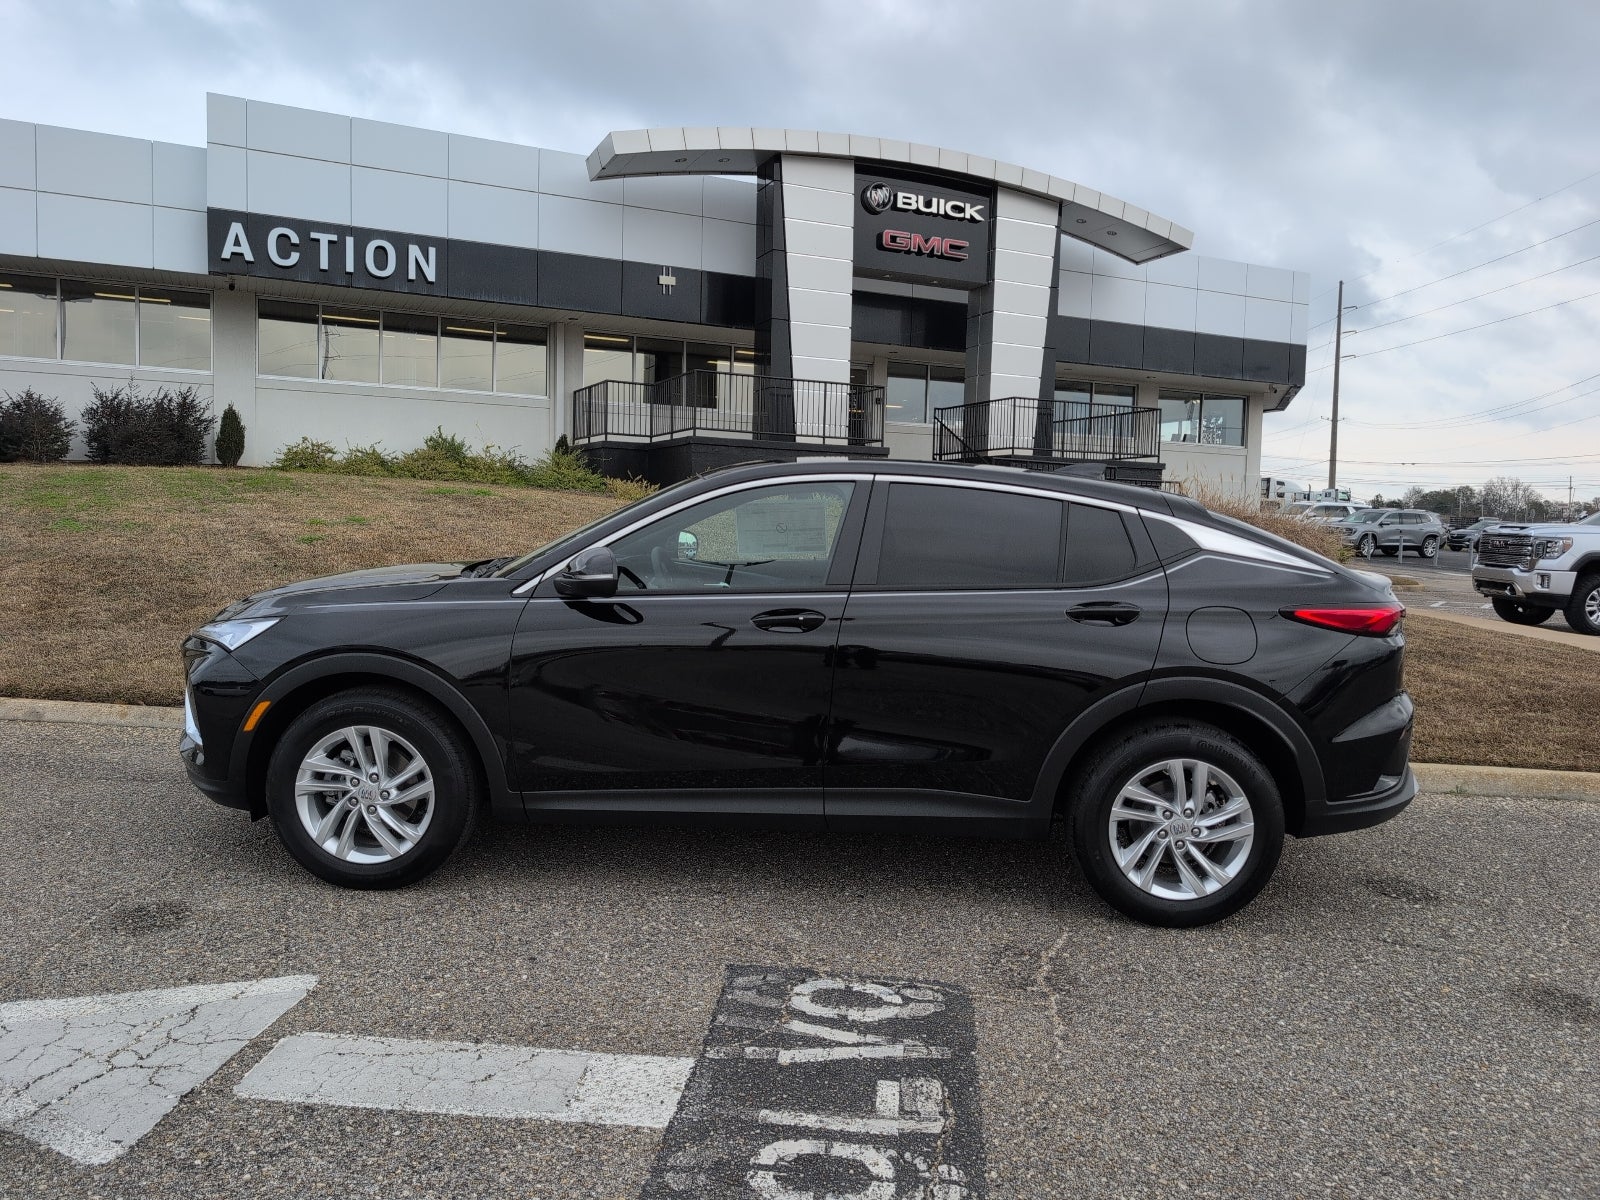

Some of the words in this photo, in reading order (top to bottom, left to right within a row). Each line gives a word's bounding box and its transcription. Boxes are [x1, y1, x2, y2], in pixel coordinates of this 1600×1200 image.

[896, 191, 985, 221] BUICK
[221, 221, 437, 283] ACTION
[882, 229, 970, 260] GMC
